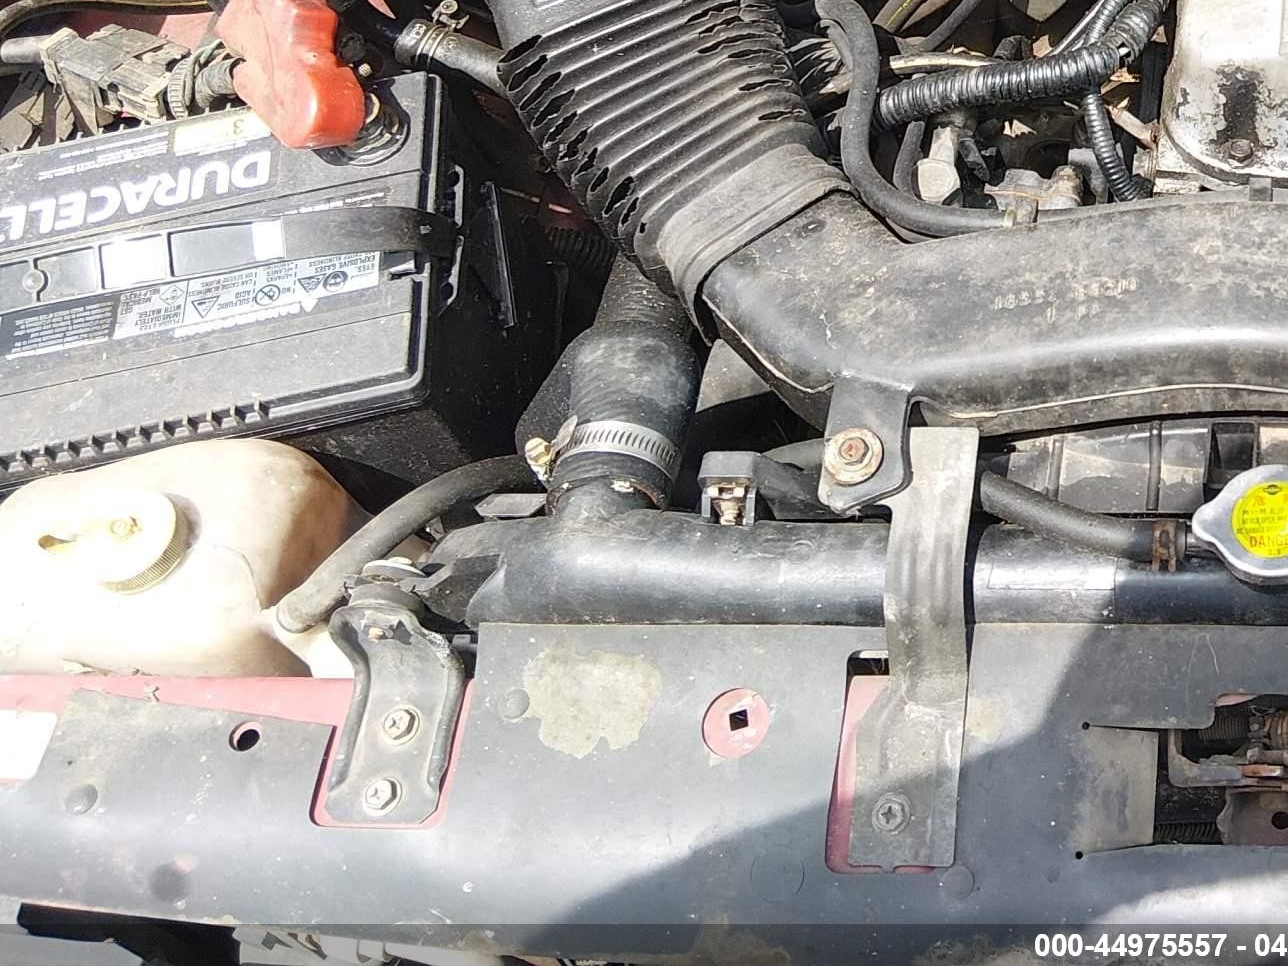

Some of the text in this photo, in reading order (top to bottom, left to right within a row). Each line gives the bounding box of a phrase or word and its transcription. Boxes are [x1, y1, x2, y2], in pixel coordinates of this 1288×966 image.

[0, 150, 272, 242] DURACELL
[314, 254, 376, 274] EXPLOSIVE GASES
[217, 298, 251, 311] SULFURIC
[135, 311, 181, 327] IMMEDIATELY
